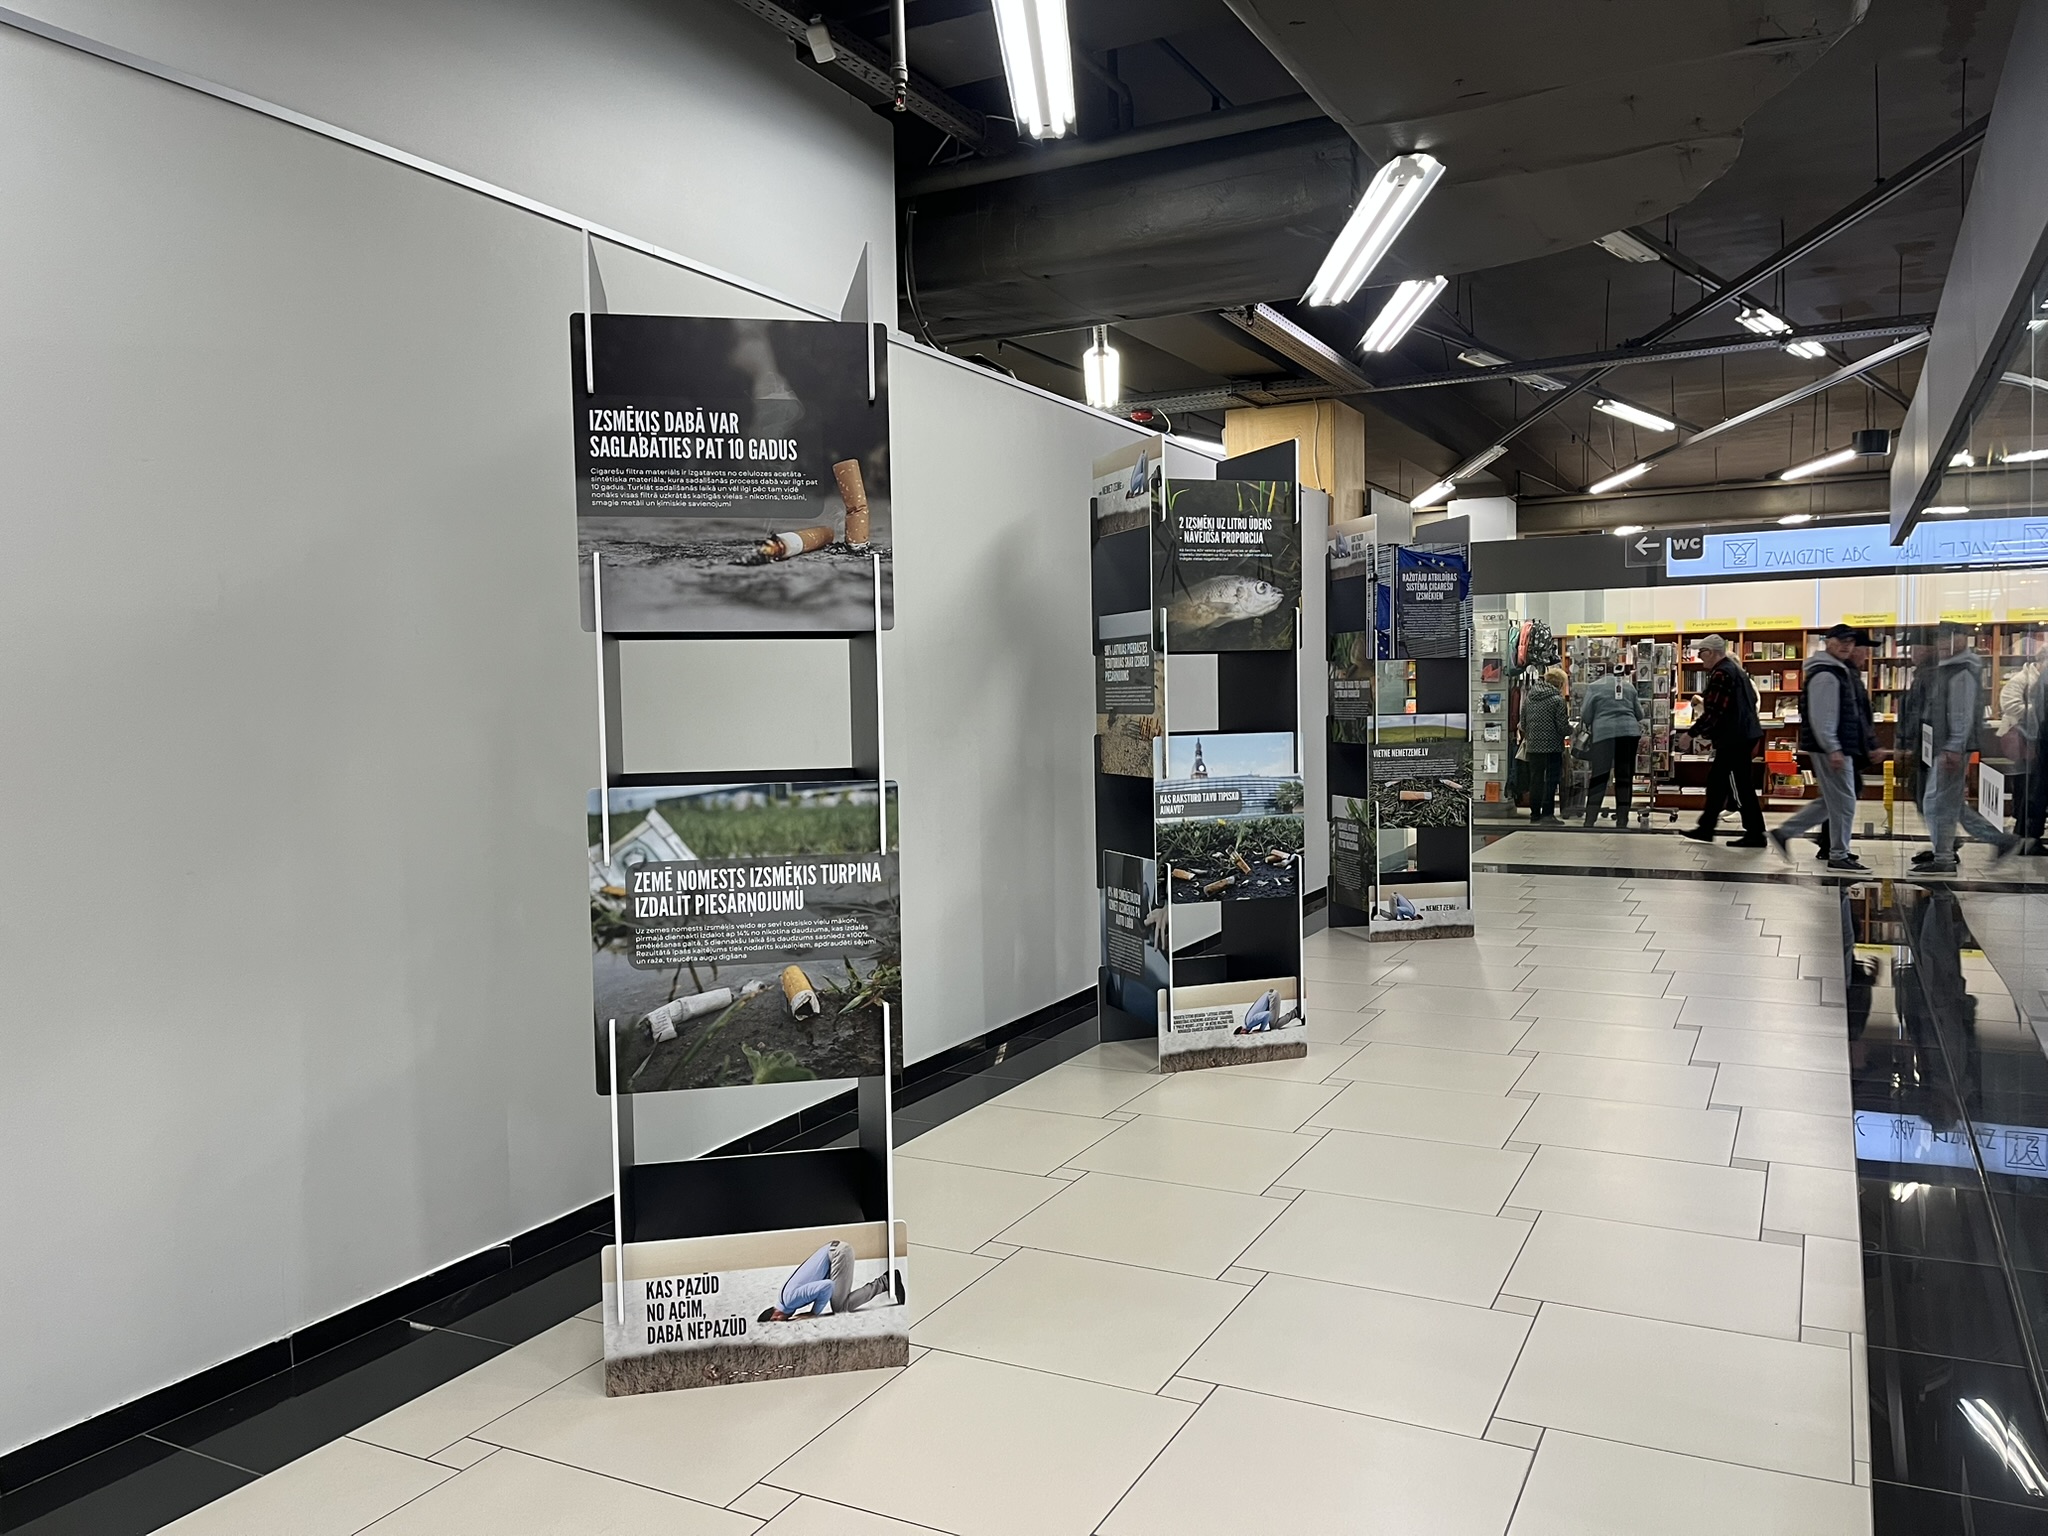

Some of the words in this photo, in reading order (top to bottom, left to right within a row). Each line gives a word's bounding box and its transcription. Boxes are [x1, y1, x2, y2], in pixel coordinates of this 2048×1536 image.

[589, 406, 660, 437] IZSMĒĶIS
[665, 407, 706, 434] DABĀ
[709, 412, 739, 434] VAR
[590, 432, 692, 459] SAGLABĀTIES
[696, 438, 723, 460] PAT
[728, 438, 744, 460] 10
[748, 439, 797, 461] GADUS
[590, 467, 625, 476] Cigarešu
[645, 468, 681, 476] materiāls
[773, 470, 802, 478] acetāta
[760, 477, 779, 485] dabā
[591, 500, 619, 508] smagie
[1178, 516, 1184, 529] 2
[1216, 517, 1226, 530] UZ
[1227, 517, 1248, 530] LITRU
[1248, 515, 1273, 531] ŪDENS
[1221, 531, 1264, 544] PROPORCIJA
[1673, 537, 1701, 551] WC
[1765, 547, 1835, 567] ZVAIGZNE
[1841, 545, 1871, 563] ABC
[1373, 749, 1391, 758] VIETNE
[1159, 794, 1171, 804] KAS
[1172, 793, 1202, 804] RAKSTURO
[1202, 793, 1217, 803] TAVU
[1160, 804, 1185, 815] AINAVU?
[634, 866, 673, 893] ZEMĒ
[677, 867, 746, 890] NOMESTS
[750, 861, 817, 890] IZSMĒĶIS
[820, 862, 882, 886] TURPINA
[635, 892, 691, 918] IZDALĪT
[695, 889, 805, 917] PIESĀRŅOJUMU
[736, 922, 756, 930] veido
[783, 919, 813, 927] toksisko
[635, 935, 664, 943] pirmajā
[748, 936, 765, 944] laikā
[777, 934, 813, 942] daudzums
[815, 932, 845, 940] sasniedz
[699, 954, 717, 962] augu
[646, 1279, 673, 1300] KAS
[677, 1272, 720, 1297] PAZŪD
[646, 1303, 665, 1322] NO
[669, 1297, 707, 1321] ACĪM,
[647, 1320, 684, 1344] DABĀ
[687, 1314, 747, 1340] NEPAZŪD
